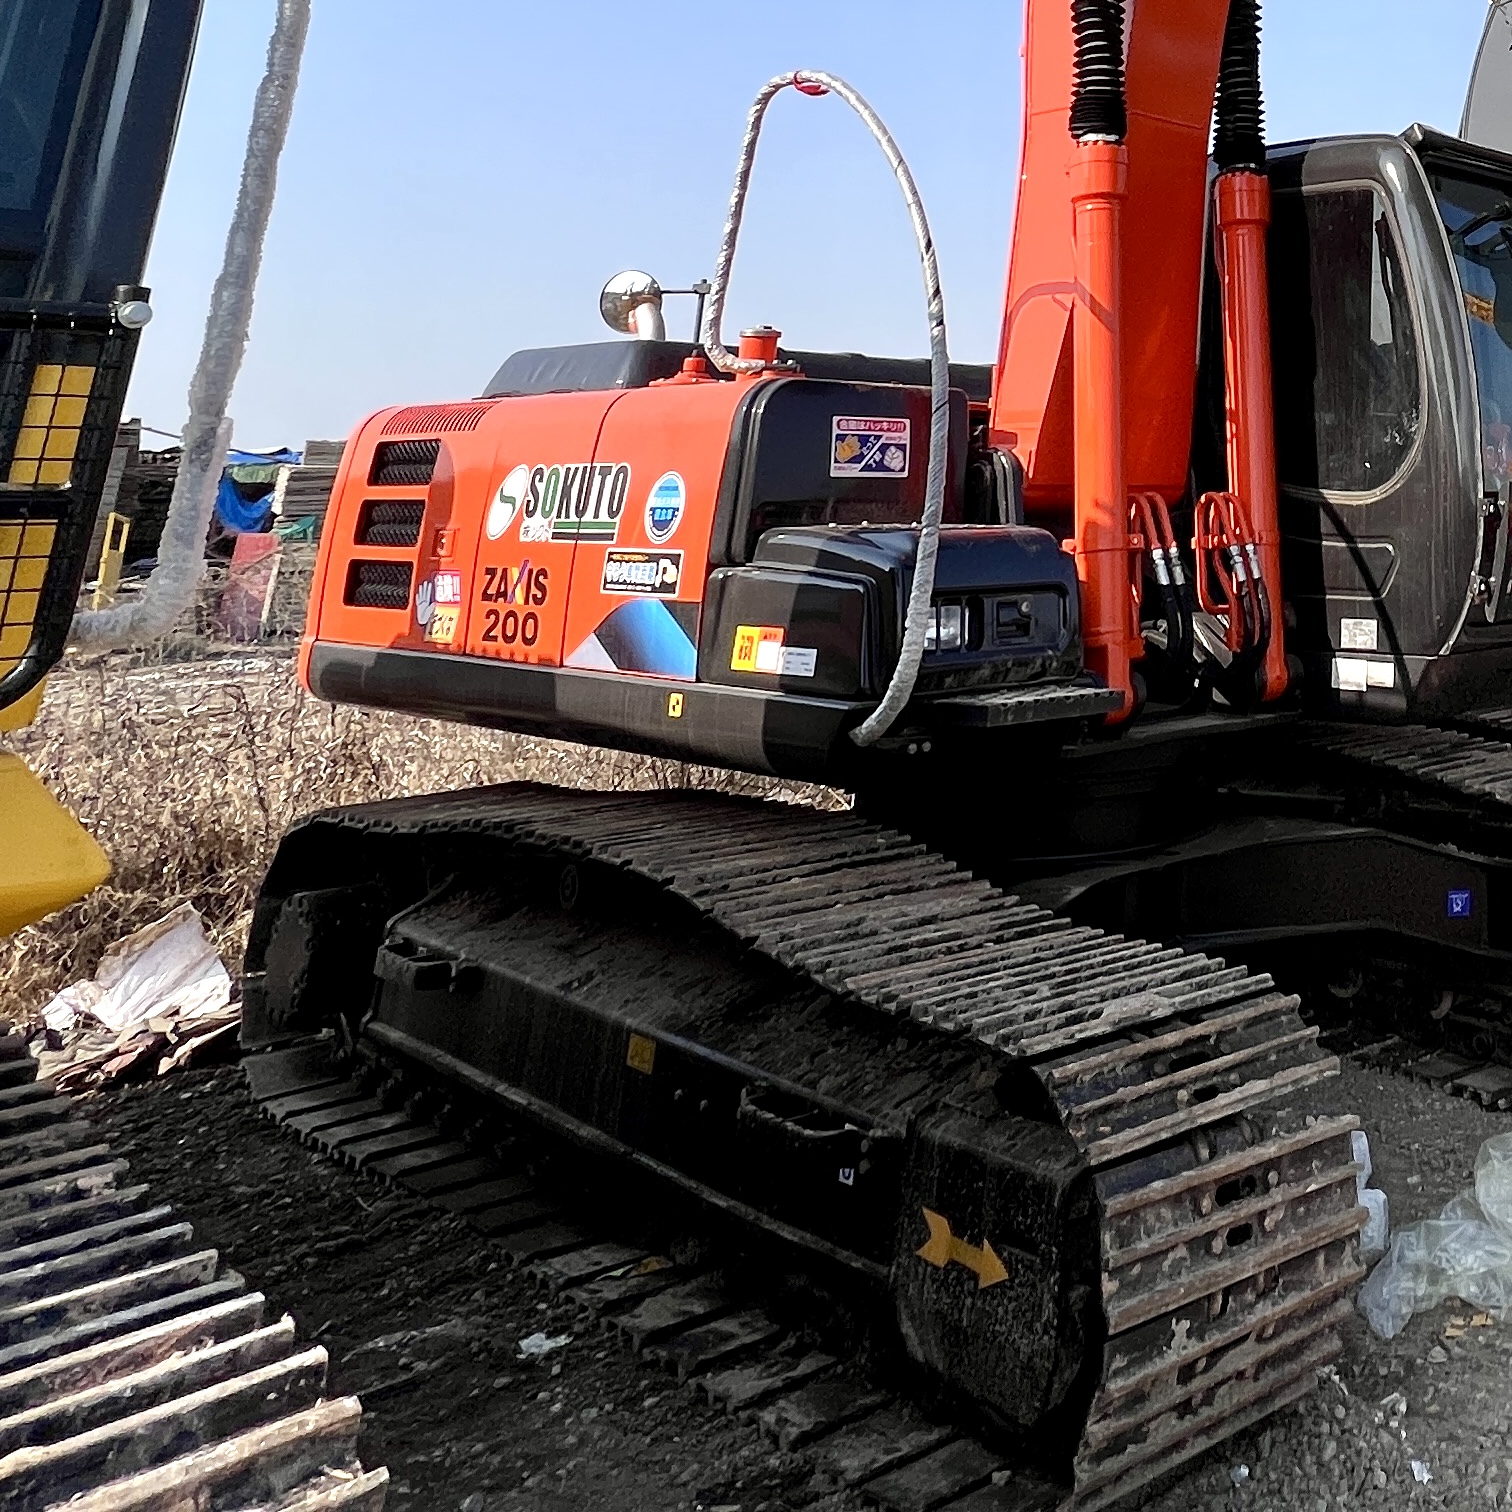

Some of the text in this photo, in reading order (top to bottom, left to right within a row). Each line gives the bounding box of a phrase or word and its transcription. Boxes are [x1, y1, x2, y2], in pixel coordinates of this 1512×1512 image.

[525, 464, 629, 520] SOKUTO
[480, 559, 549, 607] ZAXIS
[481, 608, 540, 647] 200
